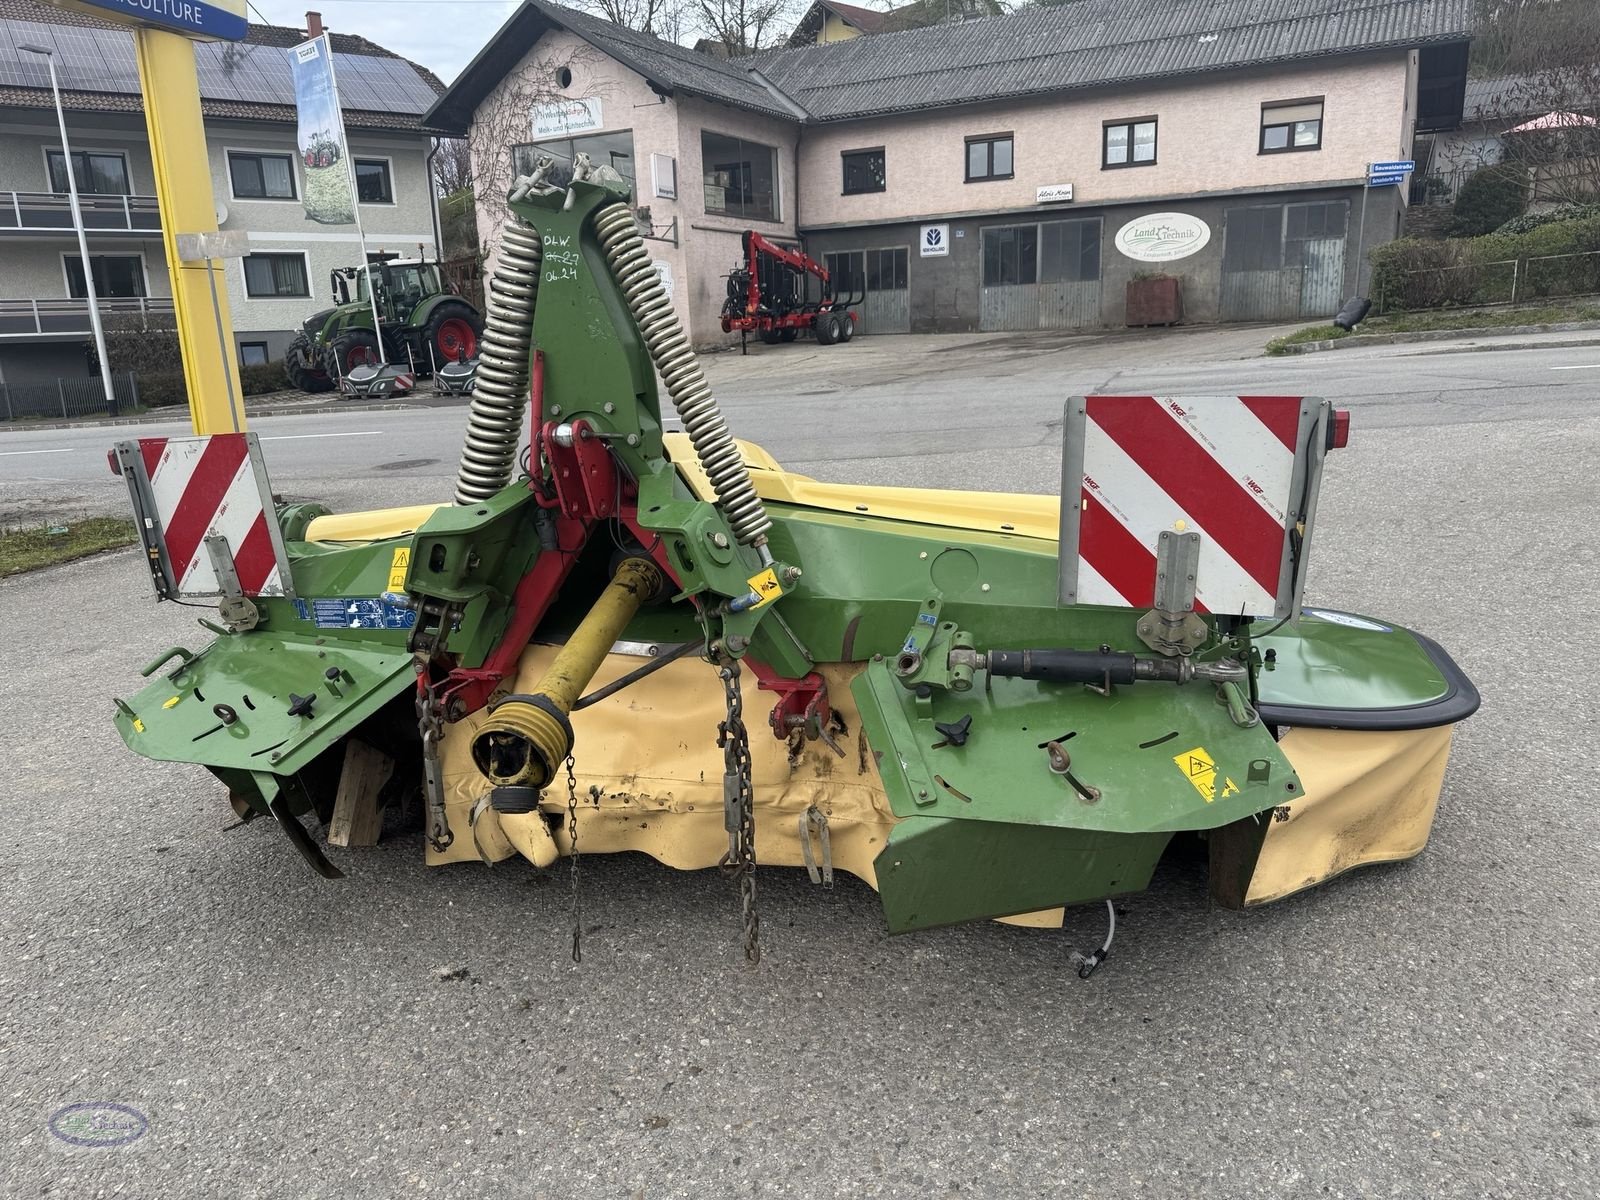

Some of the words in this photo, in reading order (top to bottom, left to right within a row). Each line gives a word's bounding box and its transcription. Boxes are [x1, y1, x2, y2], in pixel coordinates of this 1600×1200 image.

[1134, 227, 1156, 238] Land
[1162, 230, 1195, 240] Technik
[1170, 401, 1187, 417] WGF
[1084, 476, 1100, 490] WGF
[1247, 480, 1264, 494] WGF
